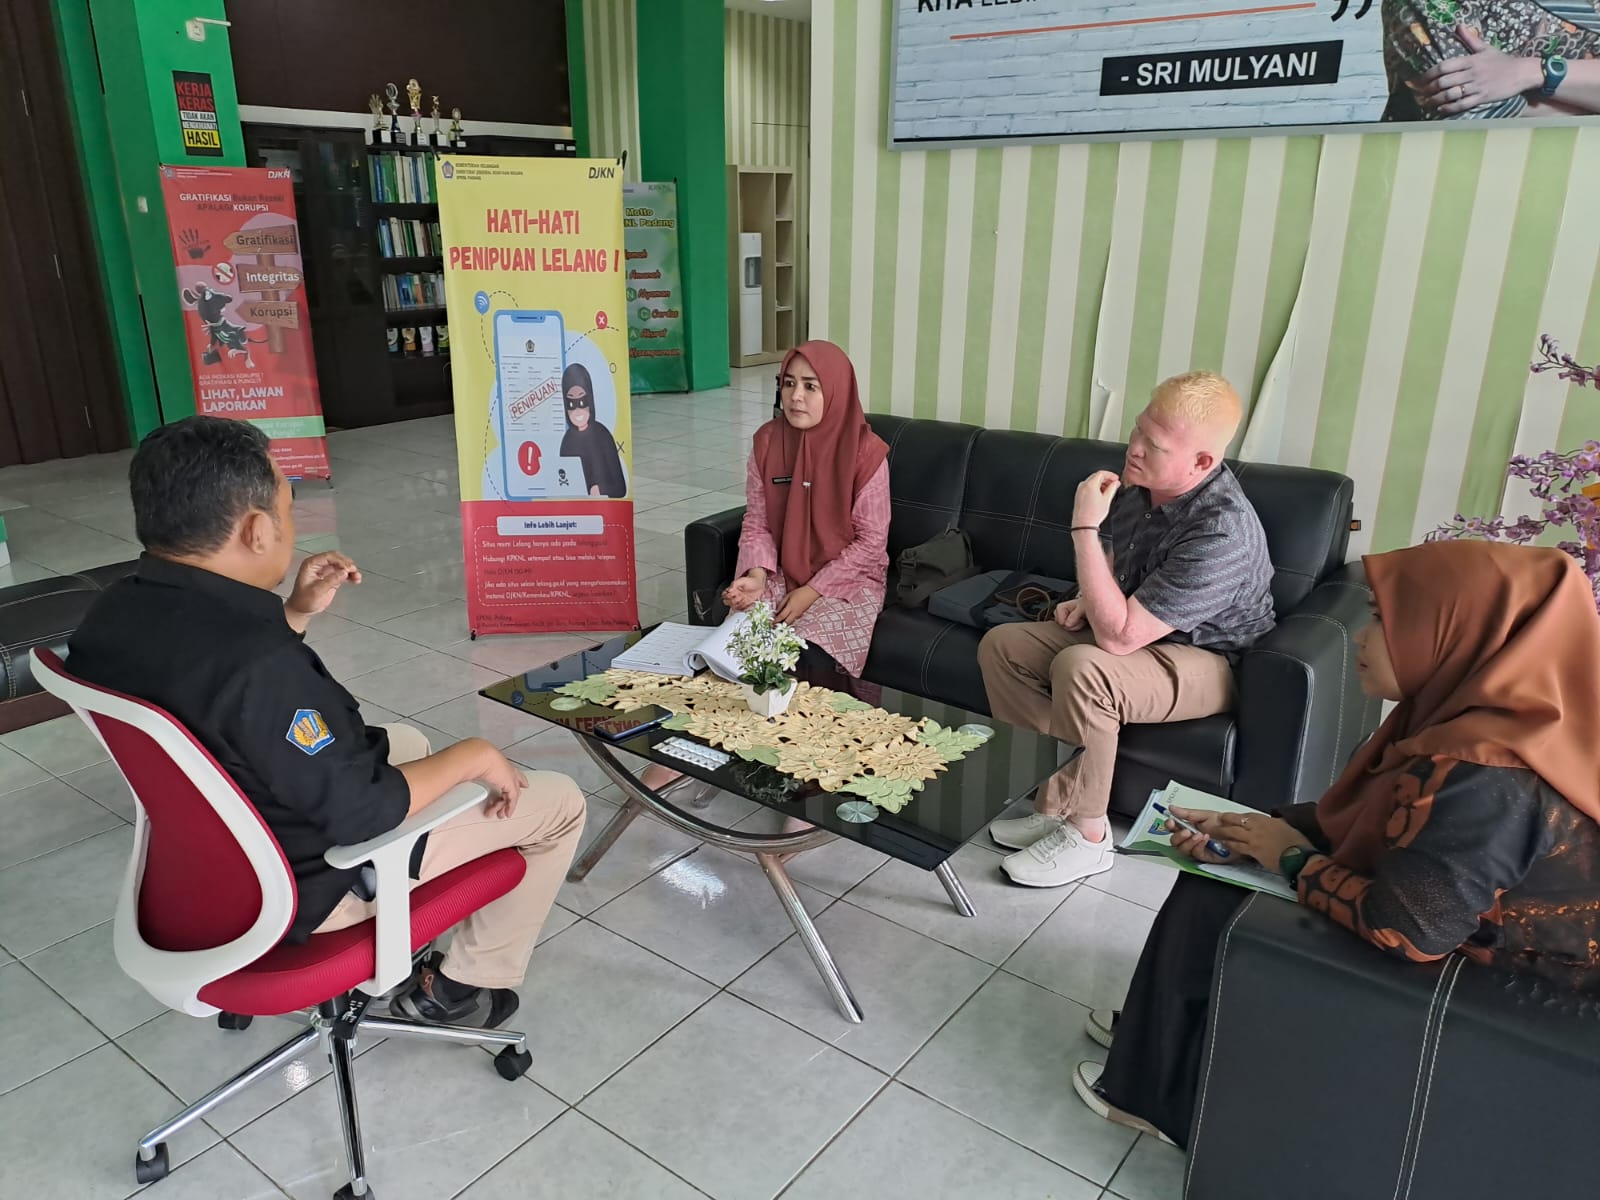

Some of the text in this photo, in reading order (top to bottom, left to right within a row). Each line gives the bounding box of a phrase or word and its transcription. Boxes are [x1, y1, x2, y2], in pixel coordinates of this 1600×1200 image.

[1136, 61, 1181, 87] SRI
[1189, 51, 1318, 83] MULYANI
[176, 82, 212, 97] KERJA
[178, 96, 214, 111] KERAS
[186, 130, 219, 146] HASIL
[267, 168, 291, 179] DJKN
[588, 166, 615, 179] DJKN
[179, 193, 232, 202] GRATIFIKASI
[232, 203, 269, 212] KORUPSI
[486, 208, 580, 235] HATI-HATI
[639, 218, 675, 229] Padang
[236, 233, 296, 246] Gratifikasi
[449, 246, 536, 272] PENIPUAN
[542, 247, 607, 273] LELANG
[246, 271, 300, 285] Integritas
[250, 305, 293, 319] Korupsi
[201, 386, 284, 401] LIHAT, LAWAN
[511, 380, 556, 418] PENIPUAN
[202, 400, 267, 413] LAPORKAN
[524, 521, 577, 530] Info Lebih Lanjut:
